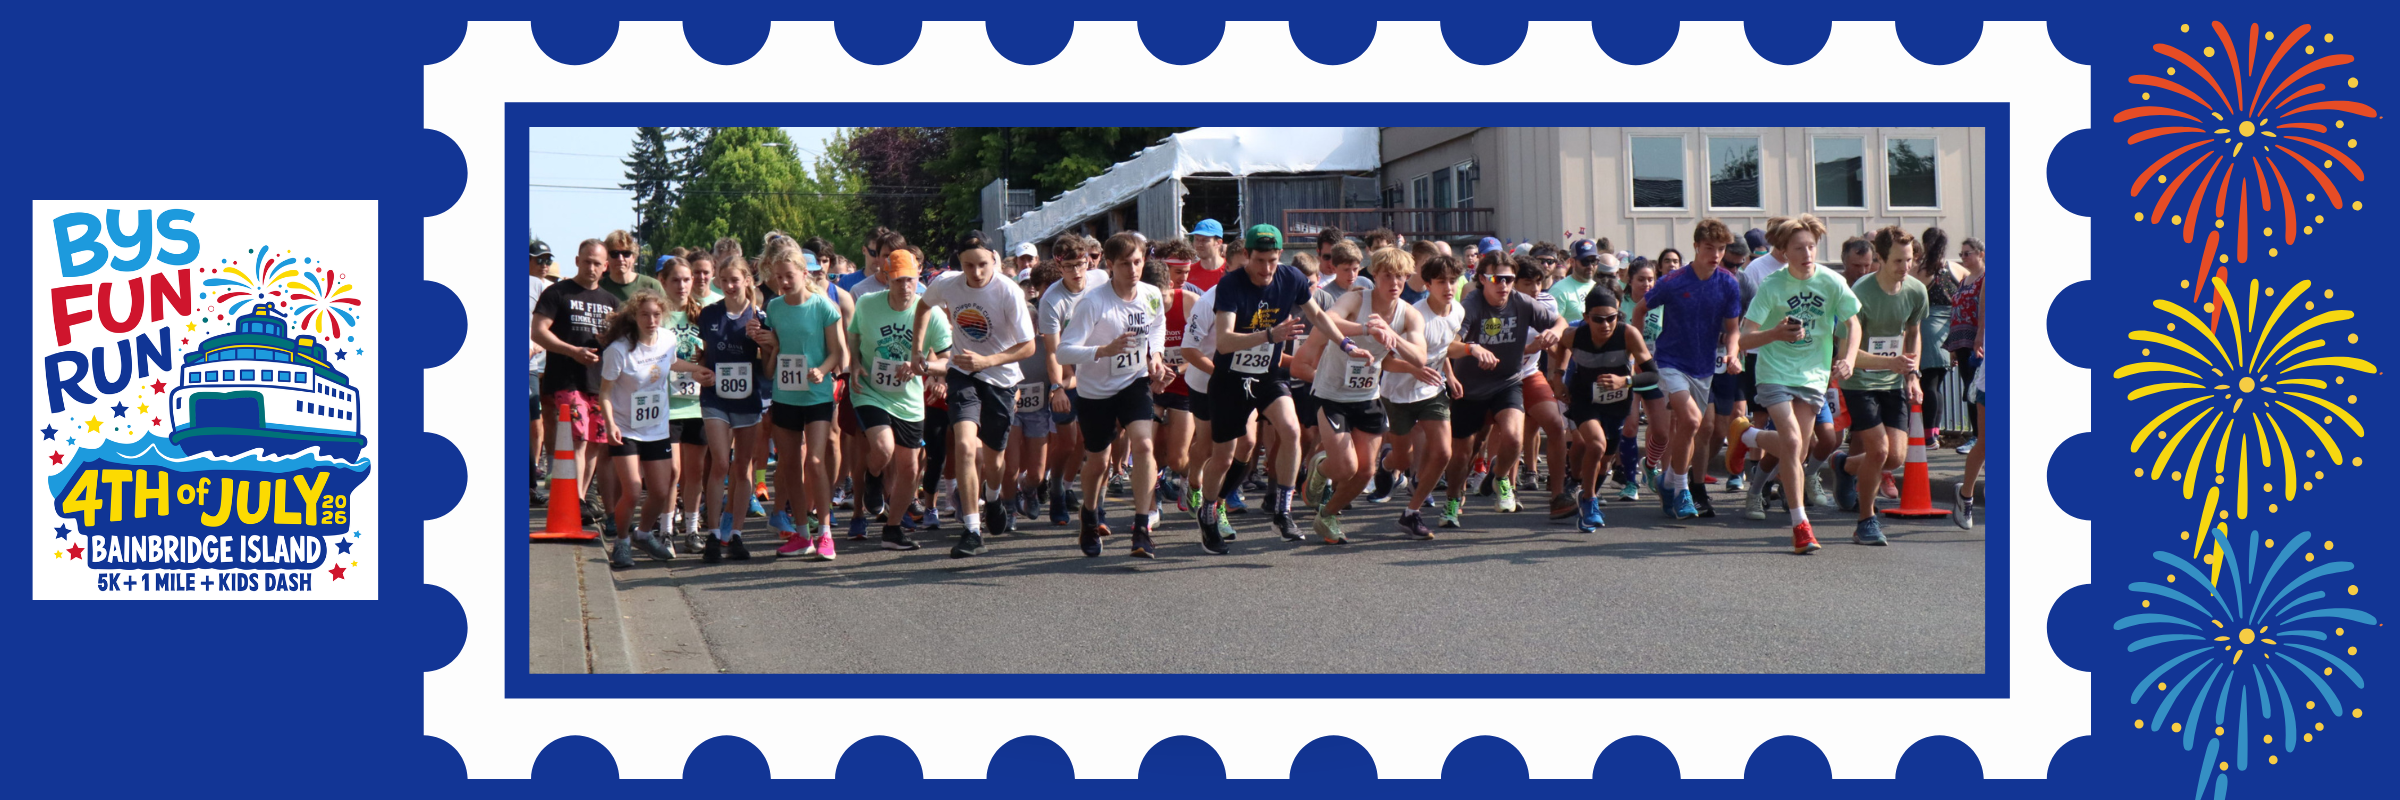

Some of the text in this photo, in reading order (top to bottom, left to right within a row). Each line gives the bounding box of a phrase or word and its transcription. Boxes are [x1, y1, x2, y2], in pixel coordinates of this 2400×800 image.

[570, 299, 584, 311] ME
[1787, 291, 1825, 309] BYS
[1127, 312, 1146, 326] ONE
[1478, 332, 1517, 345] WALL
[1116, 350, 1141, 369] 211
[1235, 353, 1271, 368] 1238
[781, 370, 803, 385] 811
[1348, 376, 1374, 389] 536
[720, 378, 748, 393] 809
[1016, 395, 1040, 409] 983
[1598, 390, 1624, 402] 158
[635, 405, 660, 421] 810
